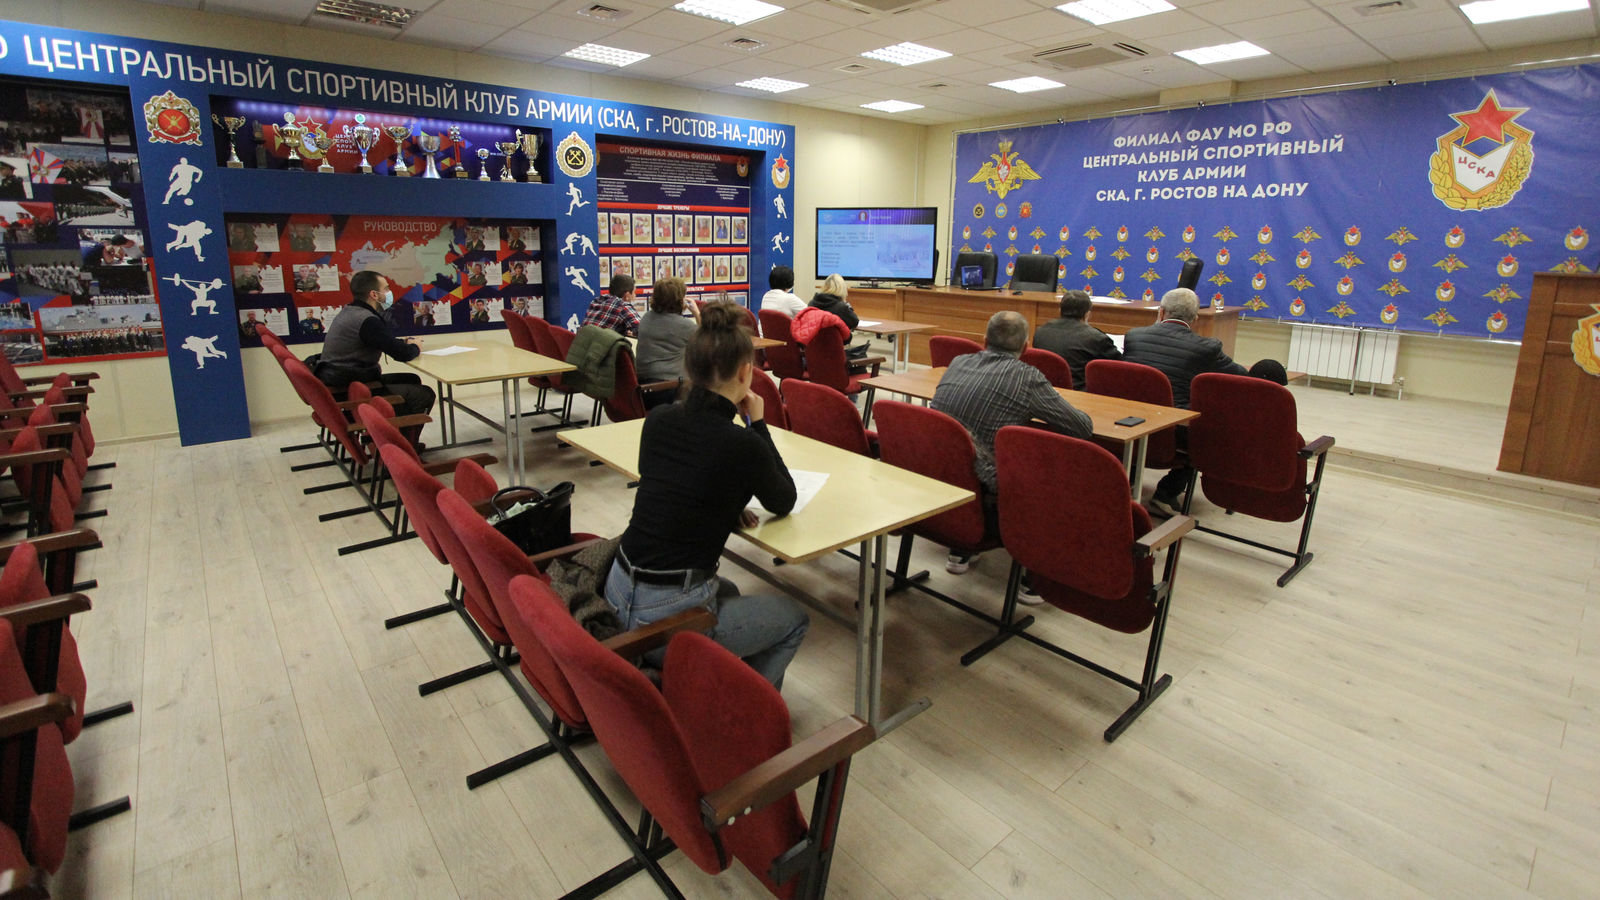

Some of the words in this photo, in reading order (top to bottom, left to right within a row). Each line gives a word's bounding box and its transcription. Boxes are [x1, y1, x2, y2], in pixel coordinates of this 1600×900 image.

[23, 34, 276, 90] ЦЕНТРАЛЬНЫЙ
[286, 68, 458, 110] СПОРТИВНЫЙ
[464, 90, 520, 117] КЛУБ
[525, 98, 593, 125] АРМИИ
[597, 106, 640, 133] (СКА,
[1113, 131, 1182, 148] ФИЛИАЛ
[1186, 127, 1224, 141] ФАУ
[1228, 124, 1257, 139] МО
[1262, 121, 1292, 136] РФ
[620, 146, 666, 157] СПОРТИВНАЯ
[667, 150, 690, 159] ЖИЗНЬ
[691, 153, 721, 162] ФИЛИАЛА
[1083, 145, 1199, 169] ЦЕНТРАЛЬНЫЙ
[1203, 134, 1344, 160] СПОРТИВНЫЙ
[1137, 168, 1179, 183] КЛУБ
[1182, 164, 1247, 180] АРМИИ
[1458, 156, 1495, 178] ЦСКА
[1096, 189, 1130, 202] СКА,
[1134, 188, 1146, 201] Г.
[1150, 185, 1218, 200] РОСТОВ
[1223, 184, 1248, 198] НА
[1251, 182, 1309, 199] ДОНУ
[363, 221, 437, 233] РУКОВОДСТВО
